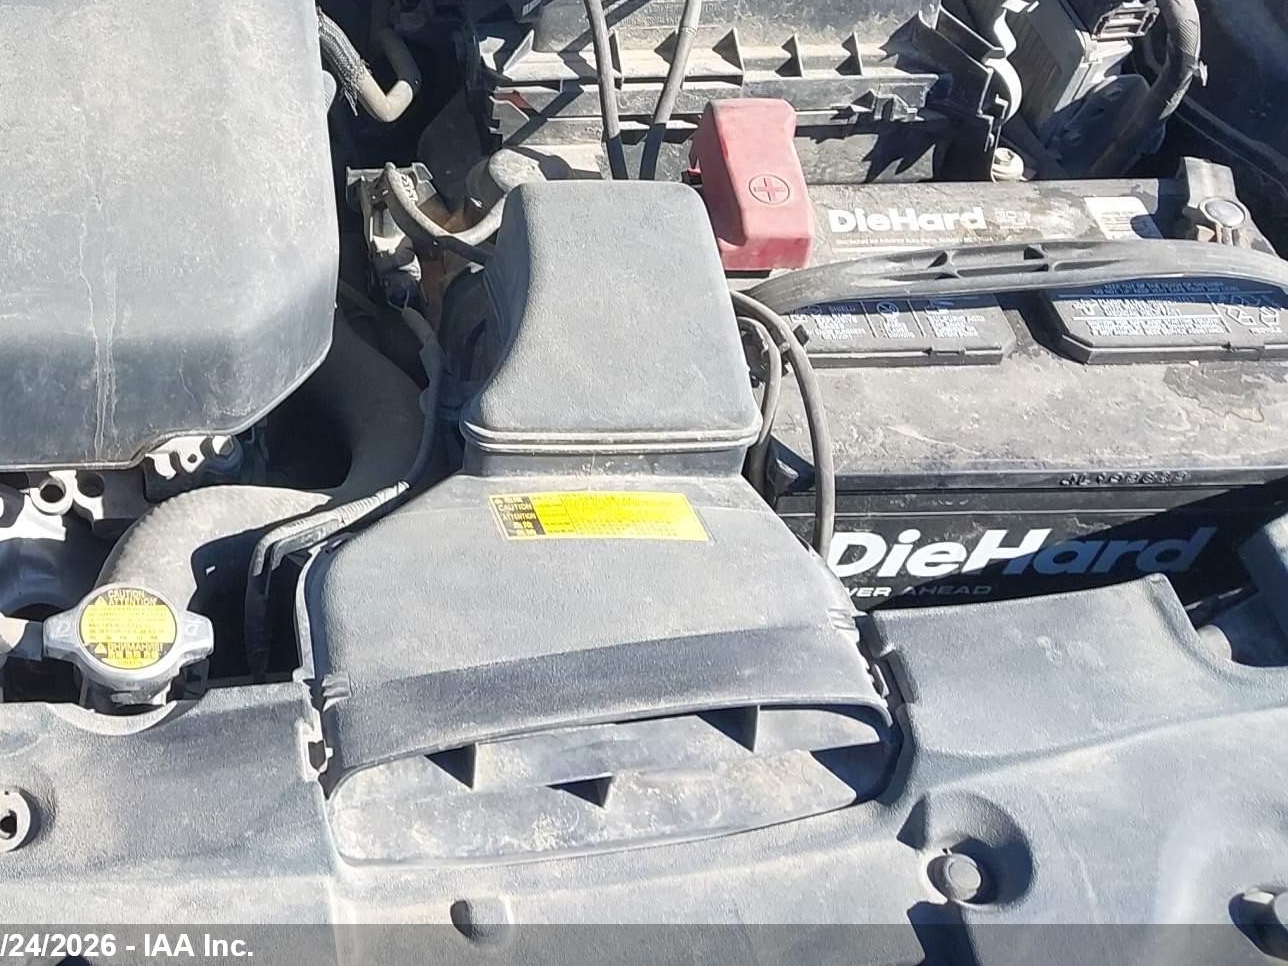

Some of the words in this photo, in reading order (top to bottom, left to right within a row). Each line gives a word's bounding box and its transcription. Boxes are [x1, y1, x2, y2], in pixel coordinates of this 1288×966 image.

[827, 206, 987, 233] DieHard
[827, 527, 1218, 578] DieHard
[901, 585, 993, 596] AHEAD
